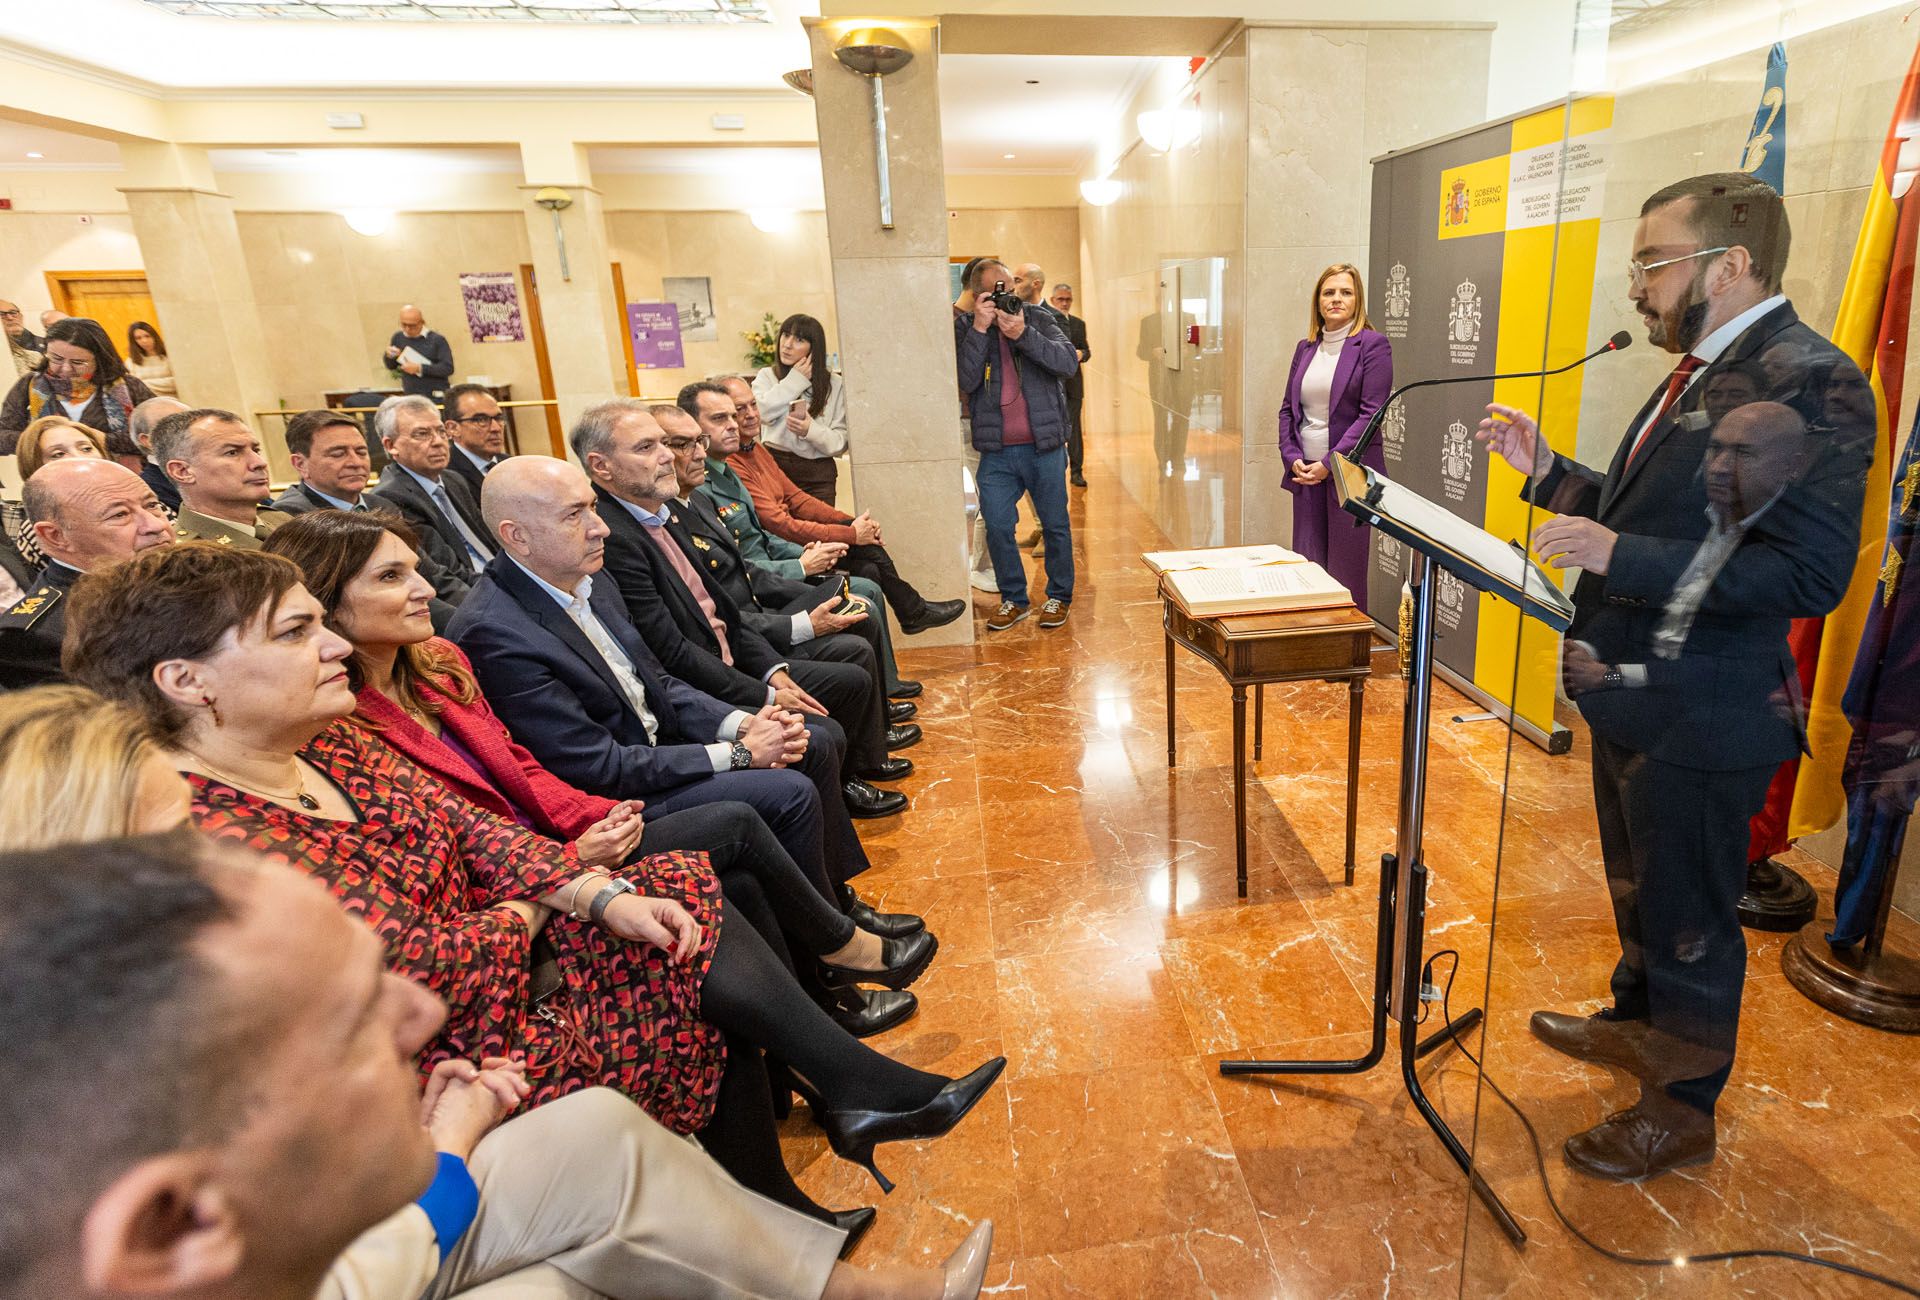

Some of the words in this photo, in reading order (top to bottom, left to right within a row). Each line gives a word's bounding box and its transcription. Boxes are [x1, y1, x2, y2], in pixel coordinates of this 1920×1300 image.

[1474, 184, 1501, 197] GOBIERNO
[1474, 199, 1480, 207] DE
[1481, 195, 1500, 206] ESPAÑA
